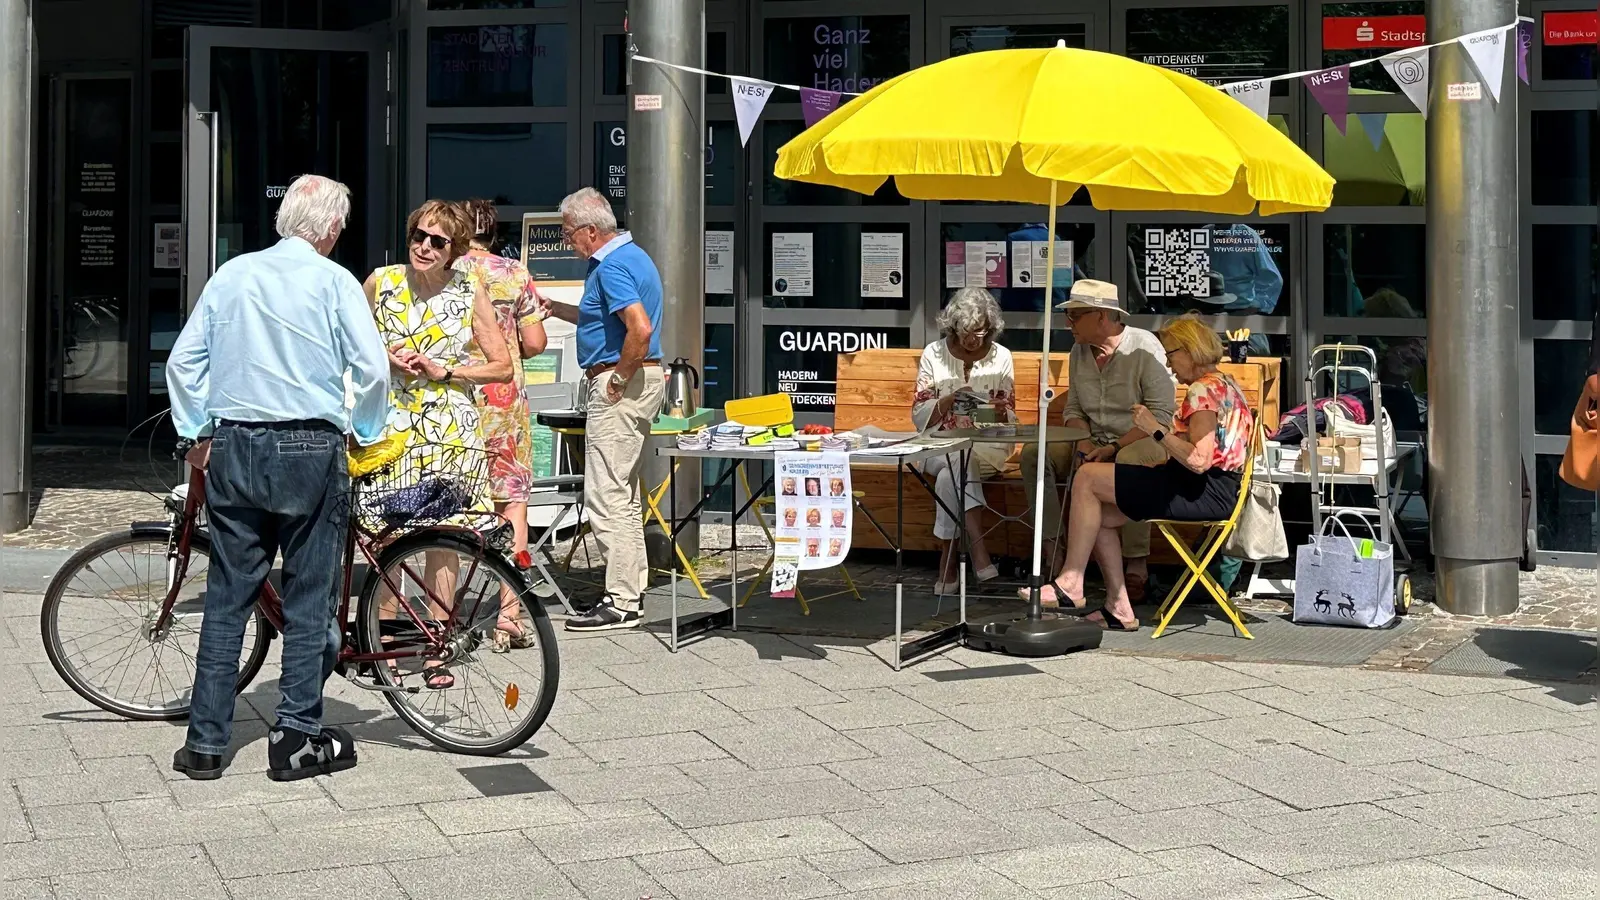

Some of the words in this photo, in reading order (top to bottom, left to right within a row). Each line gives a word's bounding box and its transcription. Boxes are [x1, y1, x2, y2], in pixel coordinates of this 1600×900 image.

[813, 24, 871, 45] Ganz
[1564, 30, 1584, 38] Bank
[813, 48, 848, 69] viel
[1143, 55, 1205, 64] MITDENKEN
[608, 176, 620, 185] IM
[780, 331, 888, 352] GUARDINI
[778, 370, 818, 380] HADERN
[778, 382, 798, 392] NEU
[791, 395, 836, 405] TDECKEN
